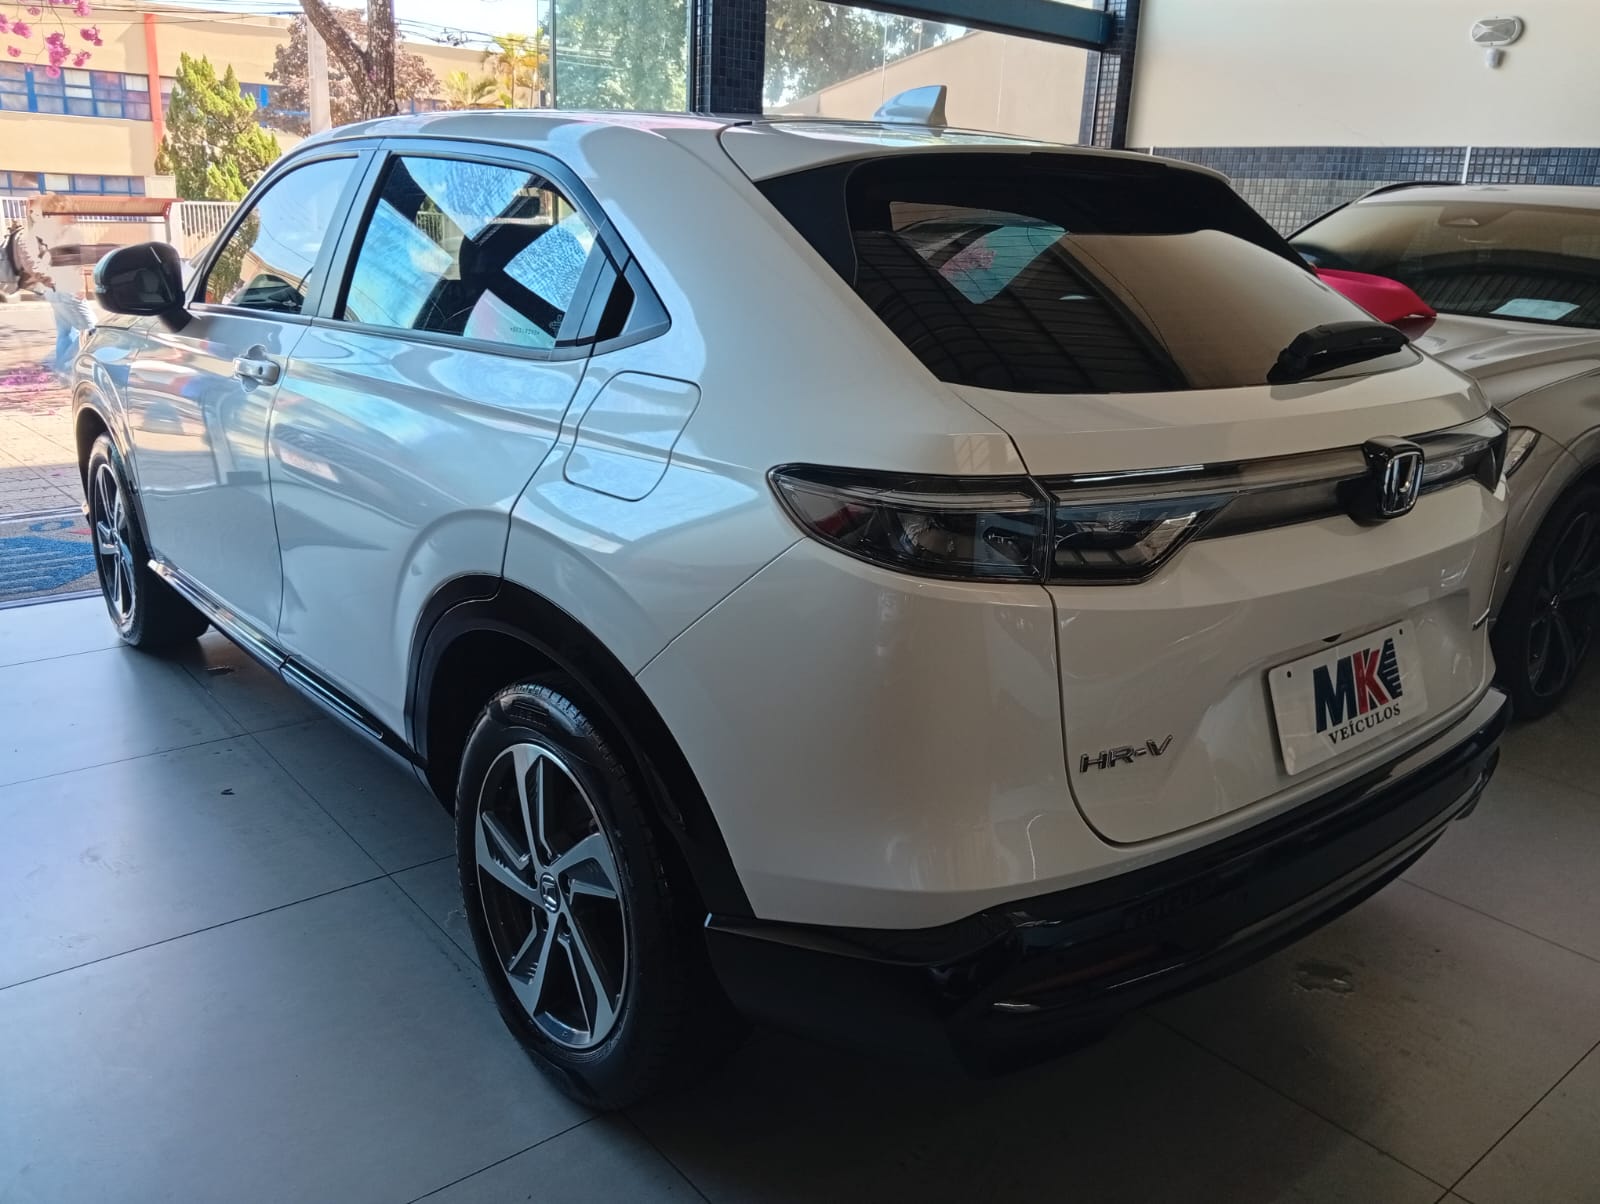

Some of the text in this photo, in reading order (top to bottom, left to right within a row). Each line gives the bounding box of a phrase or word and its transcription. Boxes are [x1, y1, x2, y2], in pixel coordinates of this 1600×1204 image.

[1313, 648, 1389, 734] MK
[1328, 703, 1400, 744] VEÍCULOS
[1080, 734, 1173, 773] HR-V
